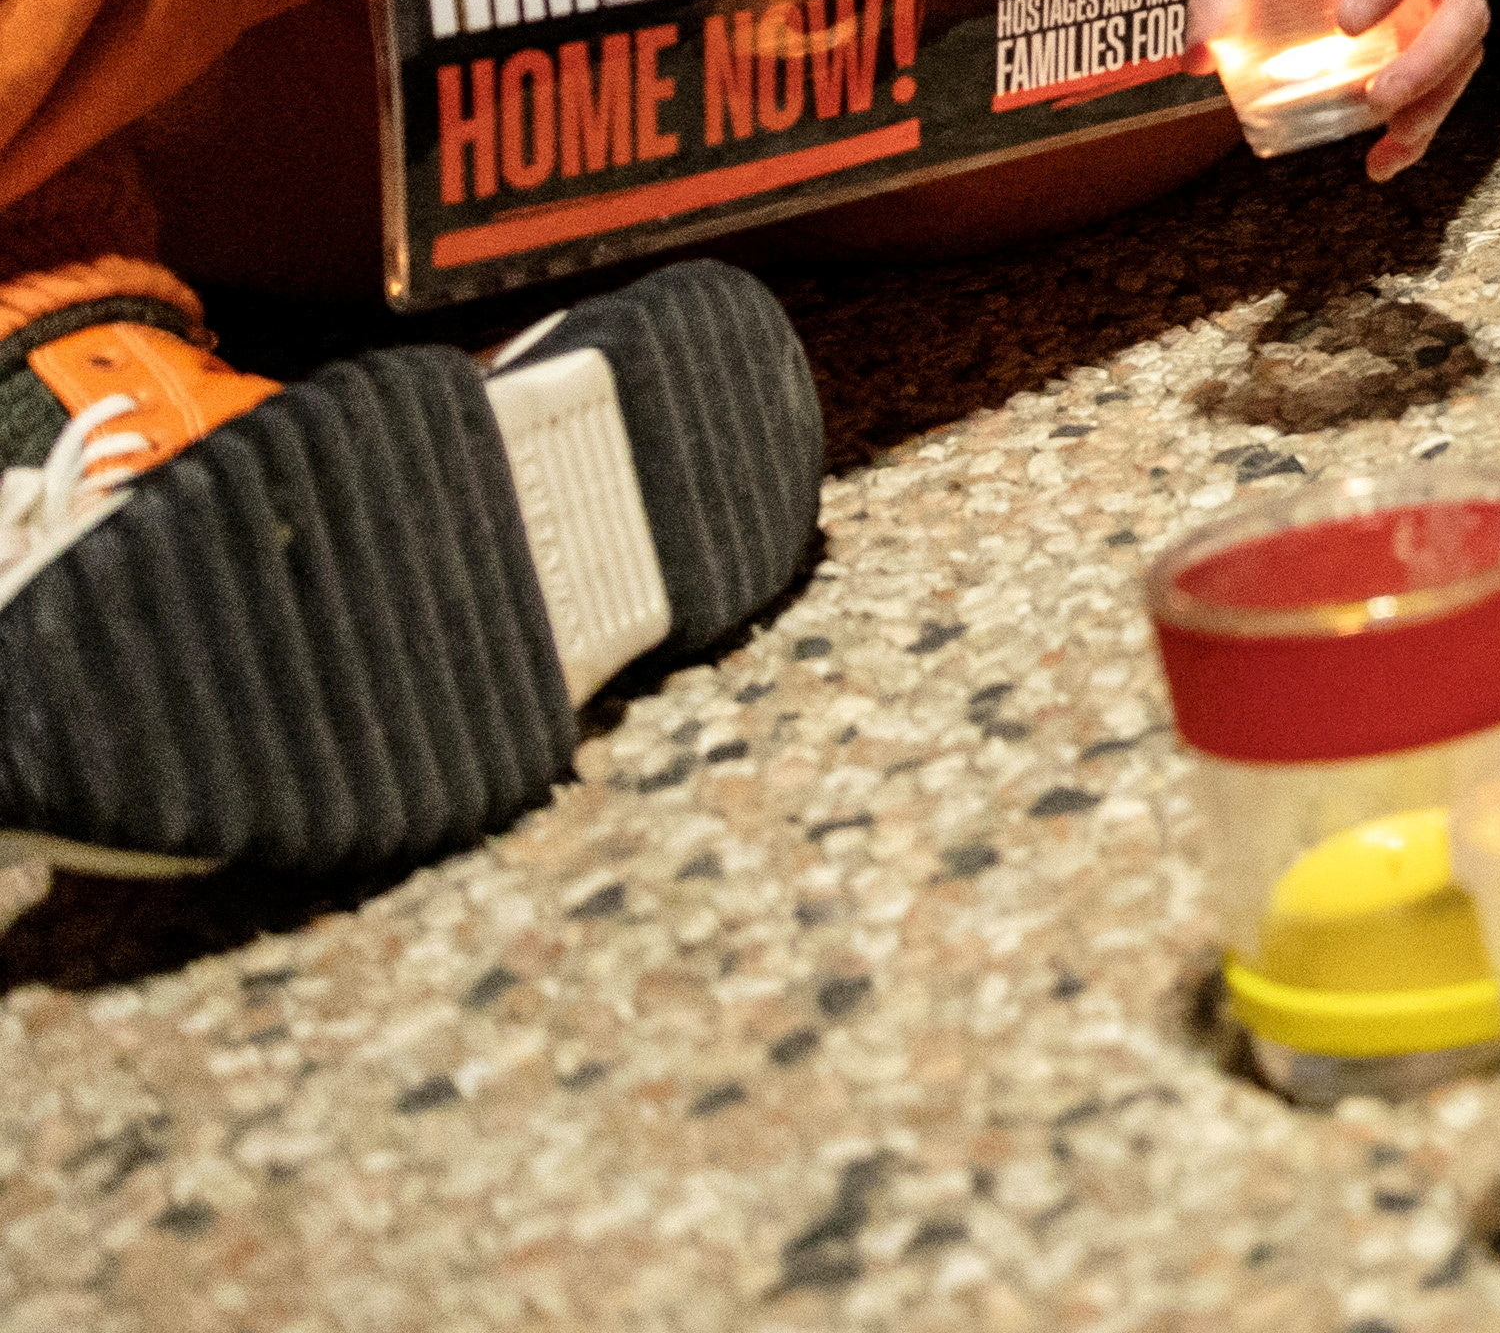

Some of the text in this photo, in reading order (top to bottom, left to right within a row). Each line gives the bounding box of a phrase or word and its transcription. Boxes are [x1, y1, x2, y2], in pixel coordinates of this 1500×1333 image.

[438, 24, 680, 205] HOME
[996, 4, 1186, 96] FAMILIES FOR
